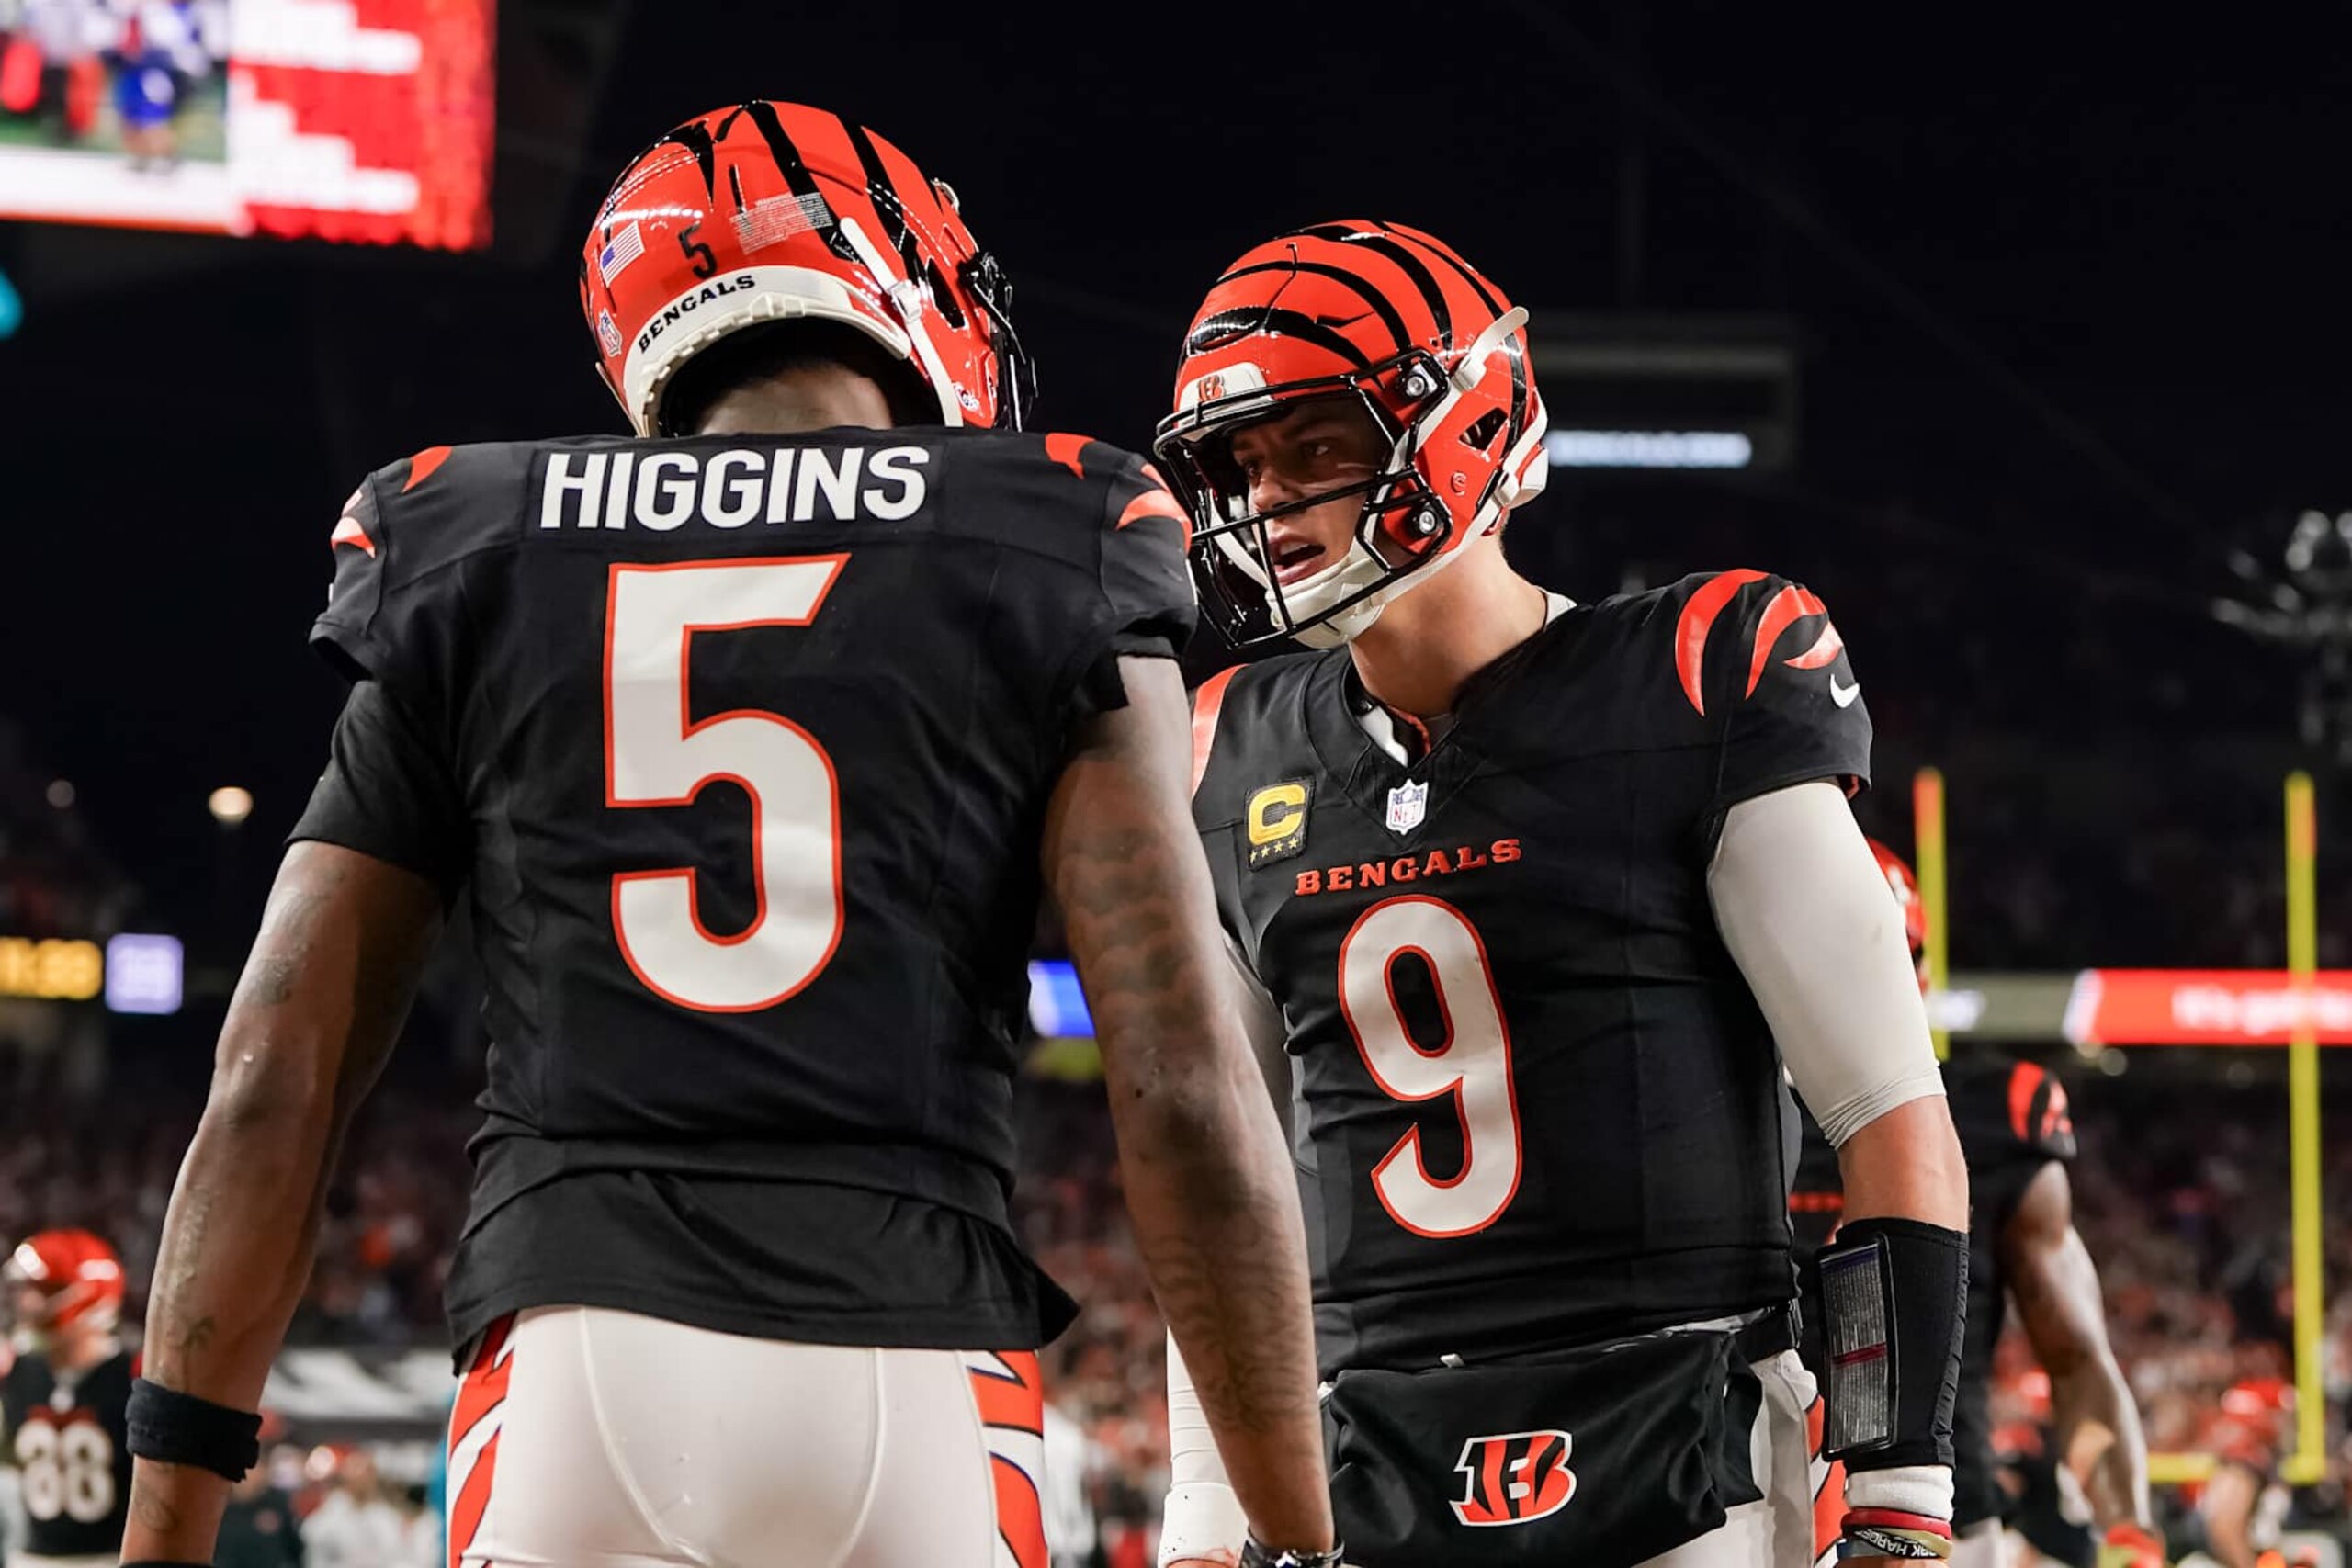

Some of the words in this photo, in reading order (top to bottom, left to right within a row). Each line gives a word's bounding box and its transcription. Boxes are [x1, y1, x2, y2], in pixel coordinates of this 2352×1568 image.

[678, 220, 718, 280] 5
[637, 275, 756, 354] BENGALS
[540, 446, 931, 531] HIGGINS
[603, 553, 852, 1013] 5
[1249, 784, 1306, 846] C
[1295, 838, 1521, 896] BENGALS
[1338, 894, 1523, 1239] 9
[1448, 1429, 1577, 1526] B
